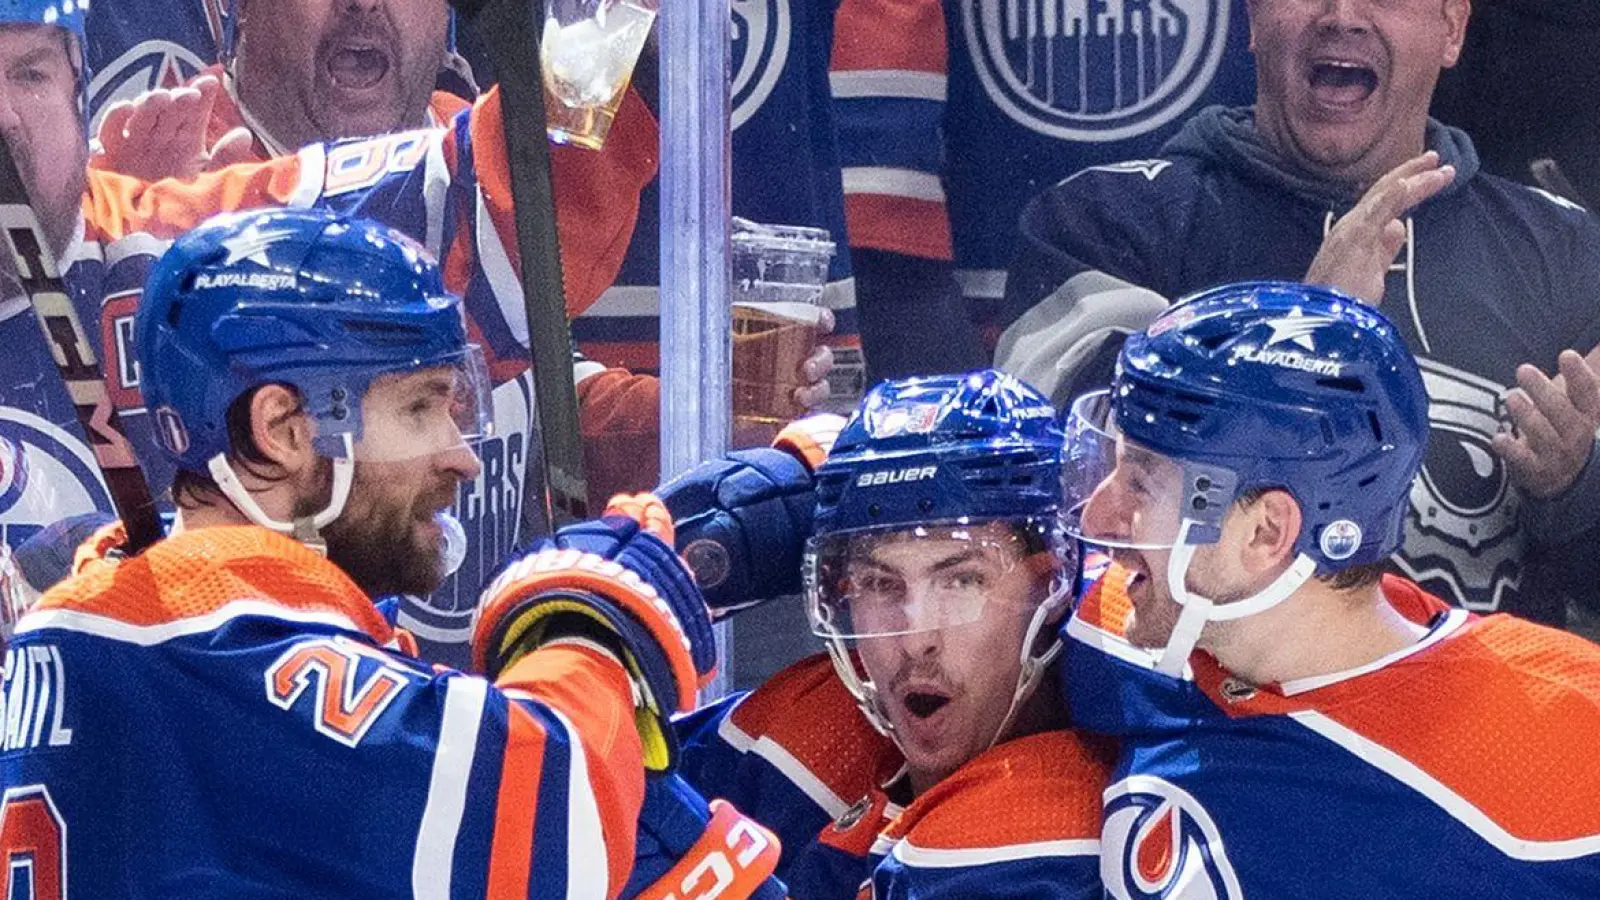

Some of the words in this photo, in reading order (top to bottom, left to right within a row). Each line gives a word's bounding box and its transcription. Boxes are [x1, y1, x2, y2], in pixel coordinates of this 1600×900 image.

[194, 272, 297, 291] PLAYALBERTA
[0, 203, 140, 468] CCM
[1234, 344, 1341, 377] PLAYALBERTA
[856, 465, 938, 488] BAUER
